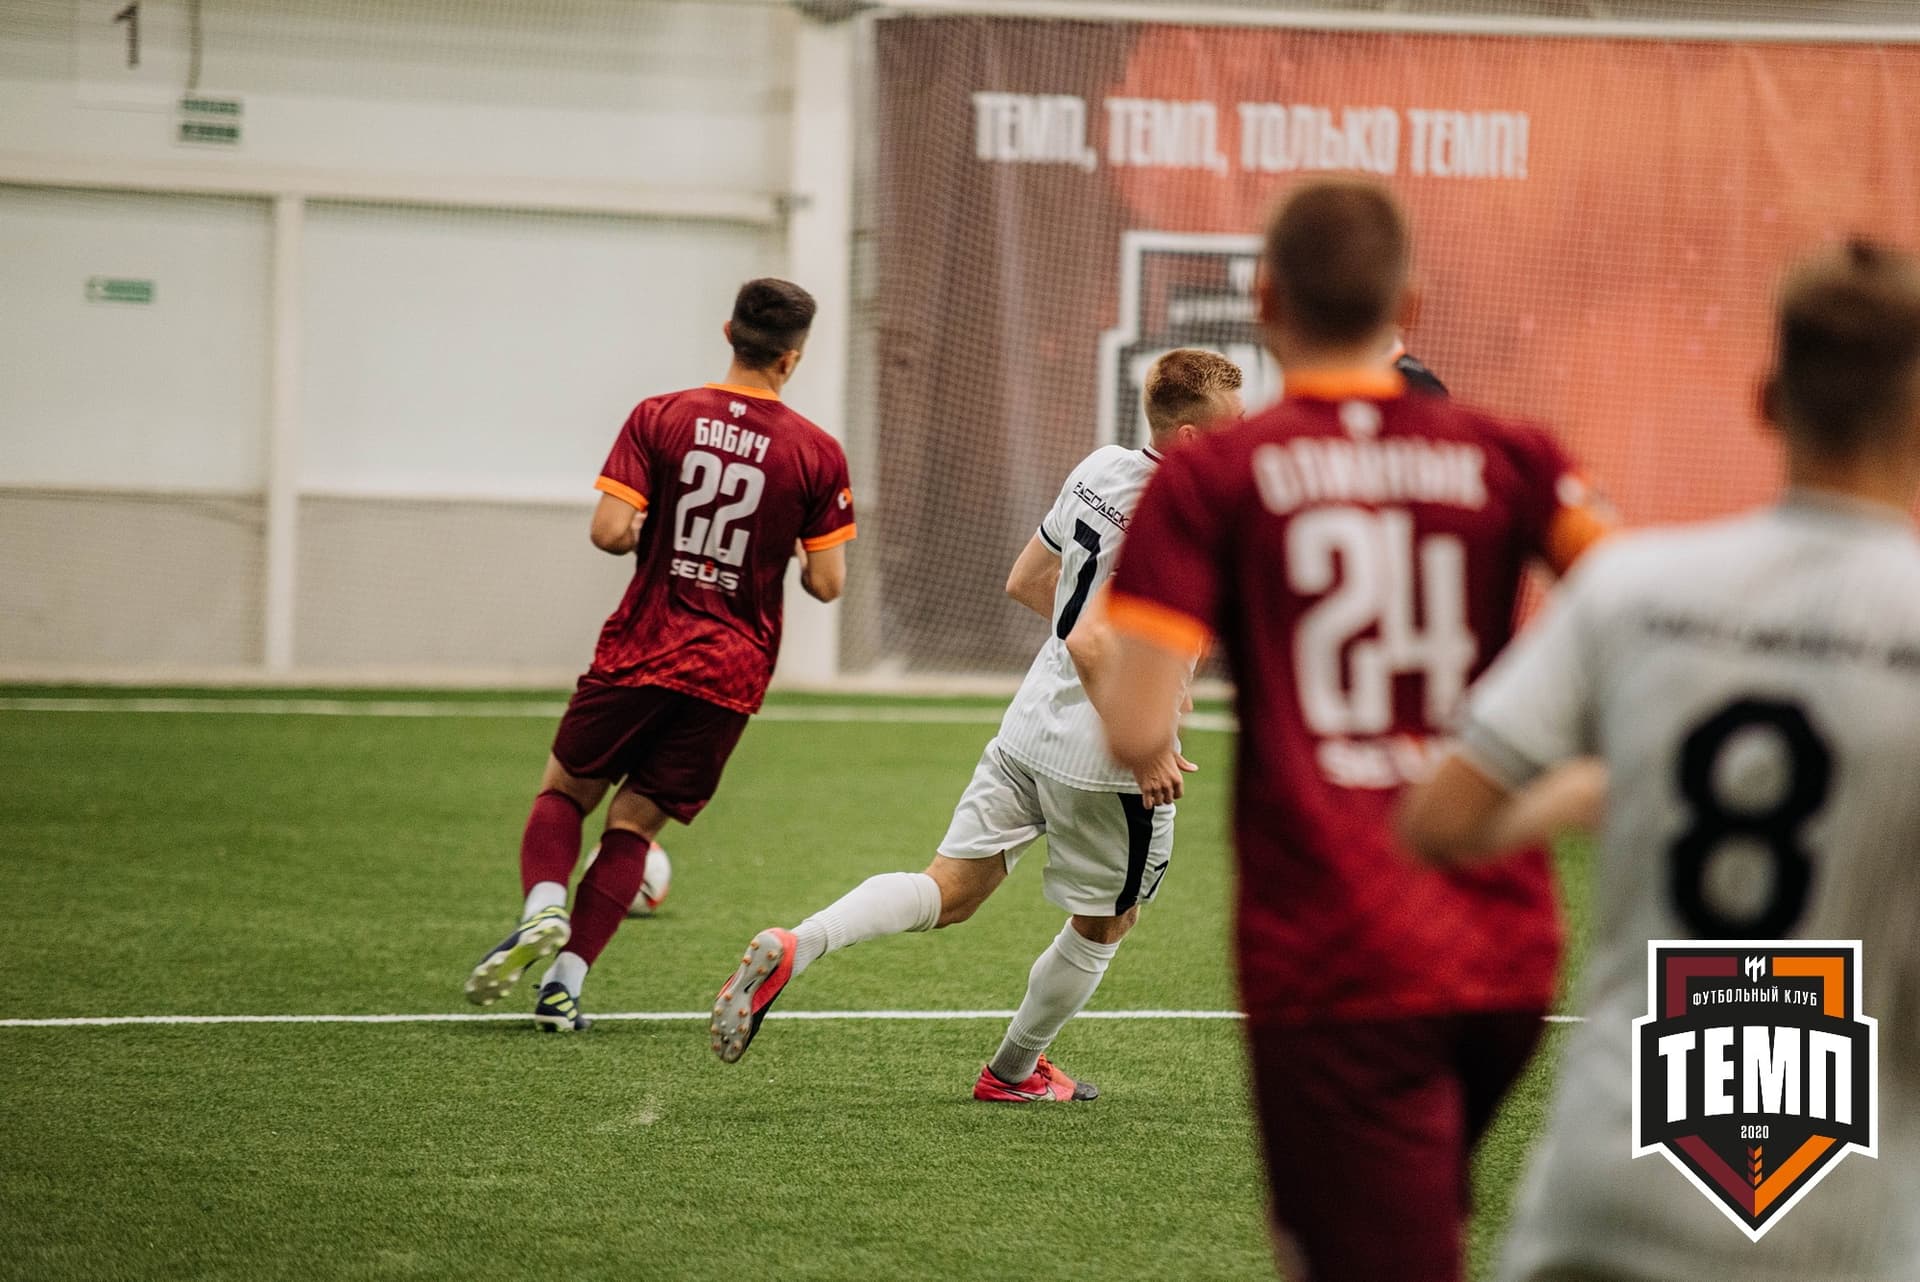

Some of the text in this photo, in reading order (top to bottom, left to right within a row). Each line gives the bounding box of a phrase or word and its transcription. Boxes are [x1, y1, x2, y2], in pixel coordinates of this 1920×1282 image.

[113, 3, 139, 66] 1
[973, 92, 1530, 180] ТЕМП, ТЕМП, ТОЛЬКО ТЕМП!
[694, 417, 771, 464] БАБИЧ
[673, 449, 766, 567] 22
[1072, 480, 1132, 532] РАСПАДСК
[1056, 517, 1103, 641] 7
[1284, 505, 1478, 737] 24
[1669, 695, 1836, 941] 8
